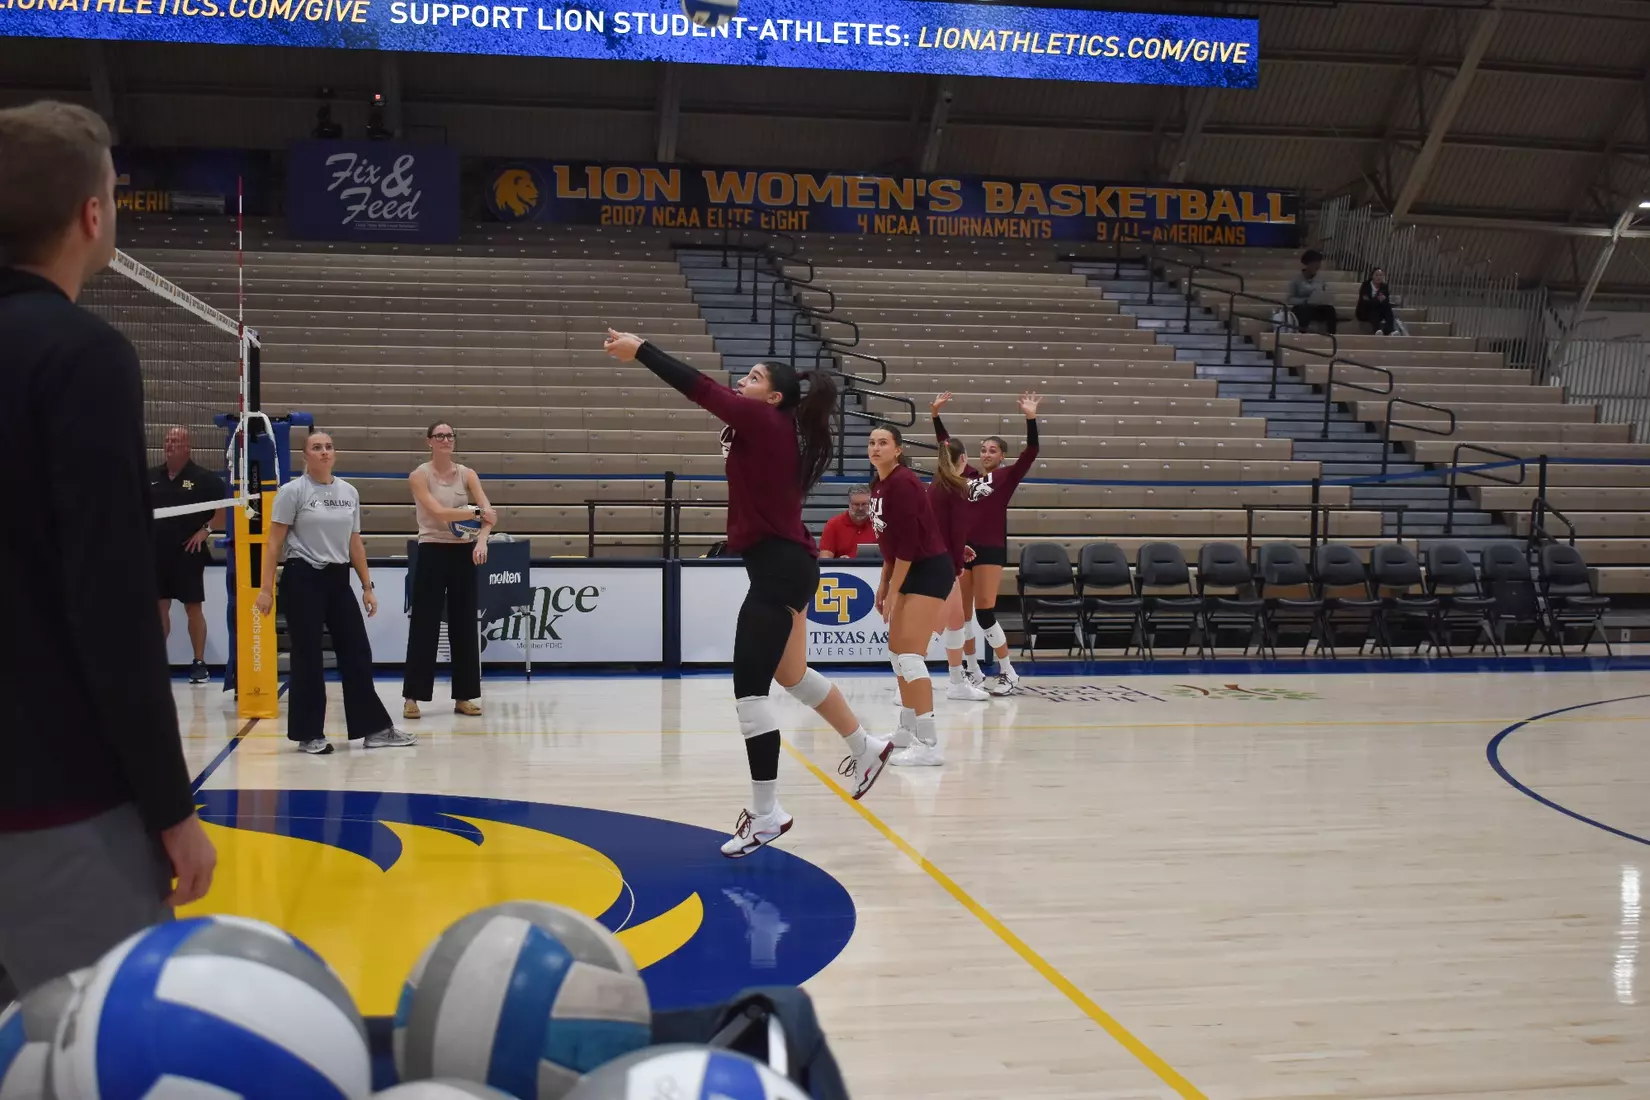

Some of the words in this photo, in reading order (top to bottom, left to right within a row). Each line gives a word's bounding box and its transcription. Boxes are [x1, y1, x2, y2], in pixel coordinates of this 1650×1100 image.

[0, 0, 370, 23] ATHLETICS.COM/GIVE
[390, 2, 528, 29] SUPPORT
[538, 8, 604, 33] LION
[918, 26, 1250, 64] LIONATHLETICS.COM/GIVE
[325, 152, 381, 191] Fix
[381, 154, 414, 198] &
[340, 187, 421, 225] Feed
[553, 165, 681, 202] LION
[701, 170, 963, 212] WOMEN'S
[982, 181, 1296, 224] BASKETBALL
[601, 205, 645, 226] 2007
[652, 207, 701, 228] NCAA
[857, 213, 868, 234] 4
[874, 214, 921, 235] NCAA
[927, 216, 1052, 239] TOURNAMENTS
[1097, 221, 1107, 241] 9
[489, 571, 521, 585] molten
[815, 577, 857, 623] ET
[810, 630, 865, 644] TEXAS
